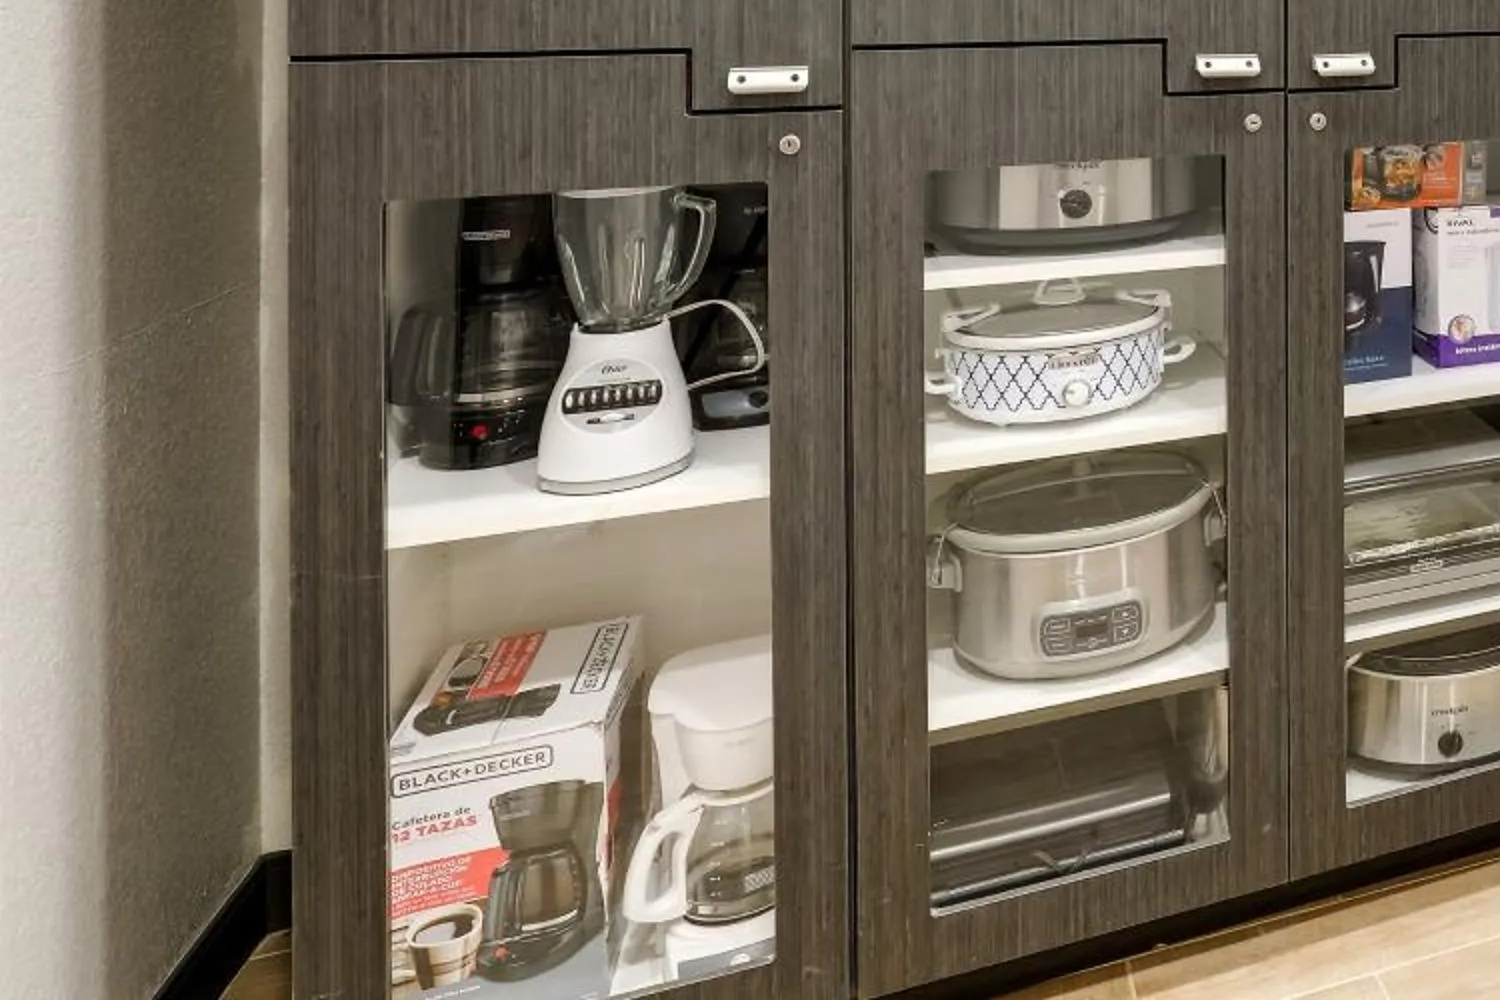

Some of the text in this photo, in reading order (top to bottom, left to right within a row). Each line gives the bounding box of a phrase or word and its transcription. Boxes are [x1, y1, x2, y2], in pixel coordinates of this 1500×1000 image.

[399, 752, 546, 791] BLACK+DECKER
[391, 807, 471, 830] Cafetera de
[391, 815, 478, 843] 12 TAZAS
